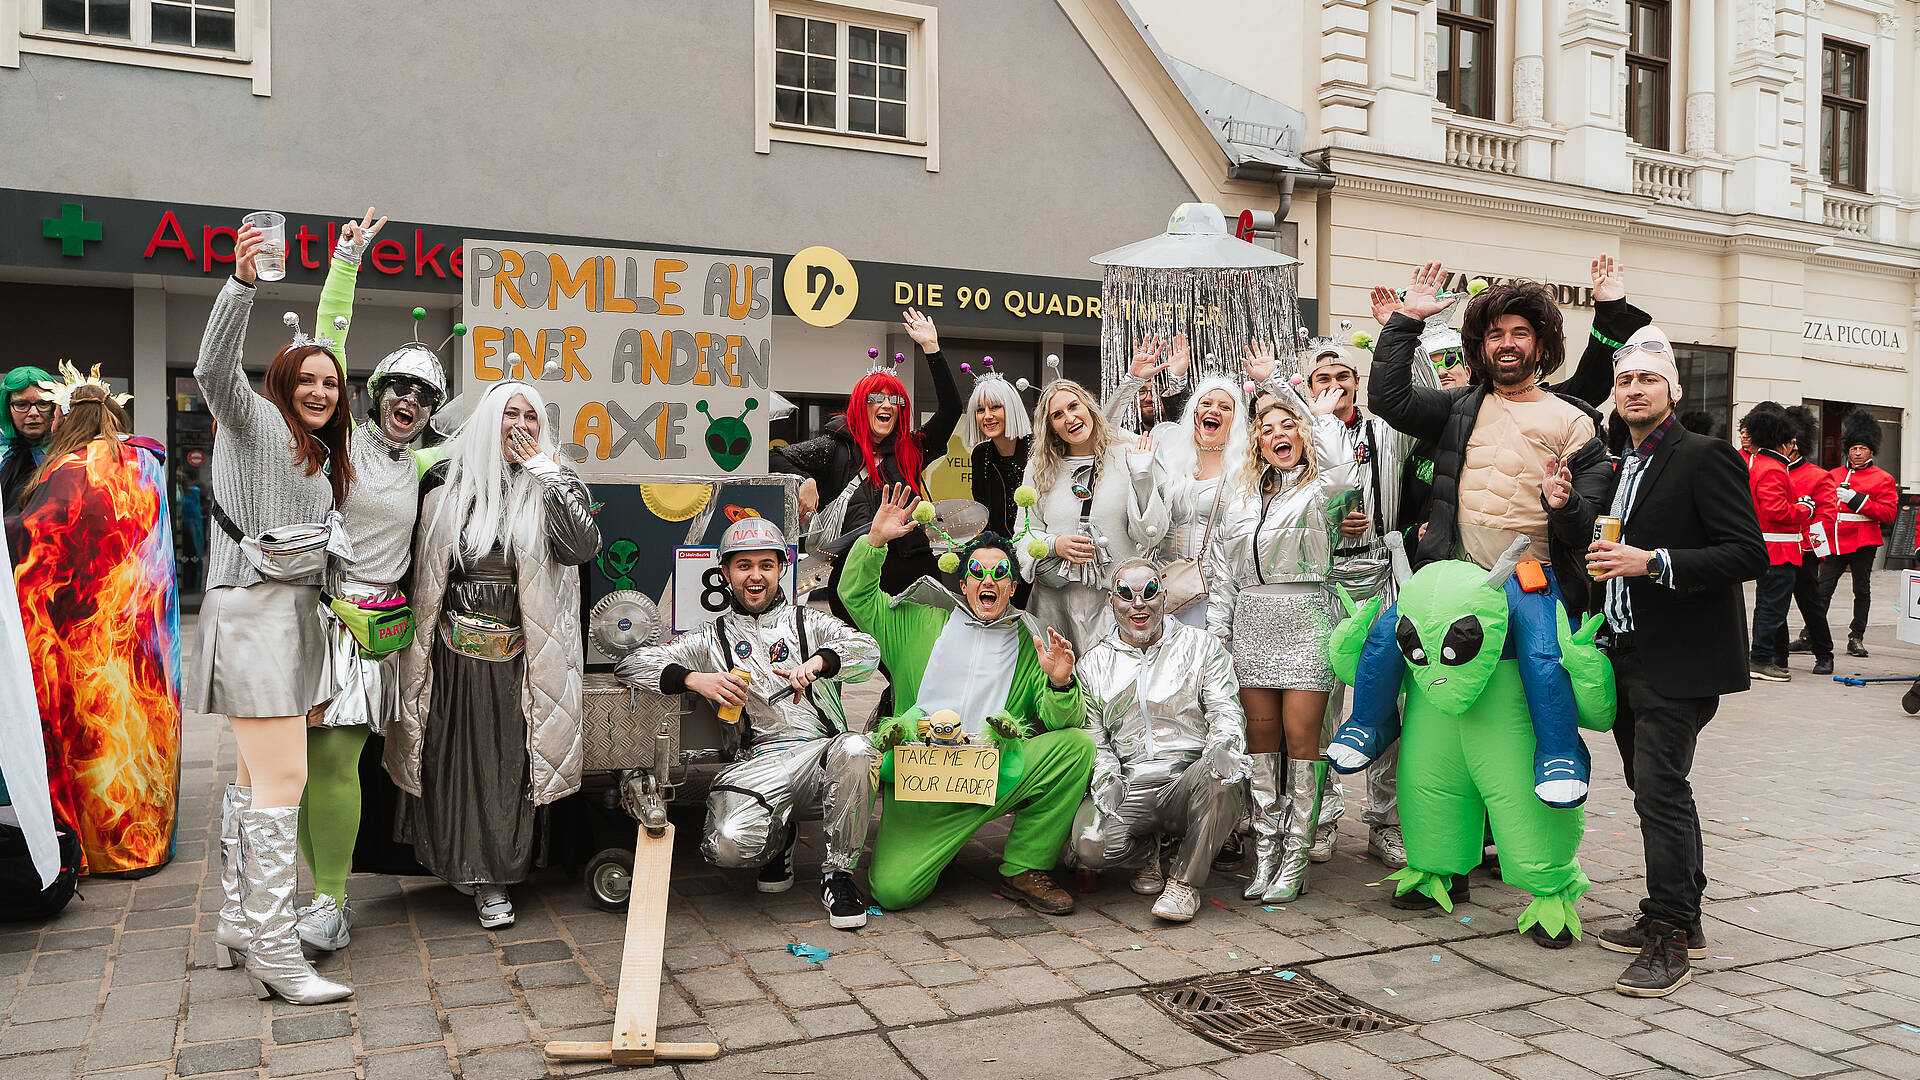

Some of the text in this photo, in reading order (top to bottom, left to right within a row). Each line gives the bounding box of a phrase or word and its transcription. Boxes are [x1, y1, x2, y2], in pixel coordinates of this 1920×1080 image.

[471, 247, 771, 320] PROMILLE AUS
[894, 281, 944, 307] DIE
[957, 286, 991, 311] 90
[1803, 321, 1901, 348] ZZA PICCOLA
[472, 326, 771, 390] EINER ANDEREN
[545, 400, 688, 464] LAXIE
[732, 528, 775, 541] NASA
[378, 620, 409, 640] PARTY
[899, 749, 997, 770] TAKE ME TO
[900, 773, 995, 798] YOUR LEADER
